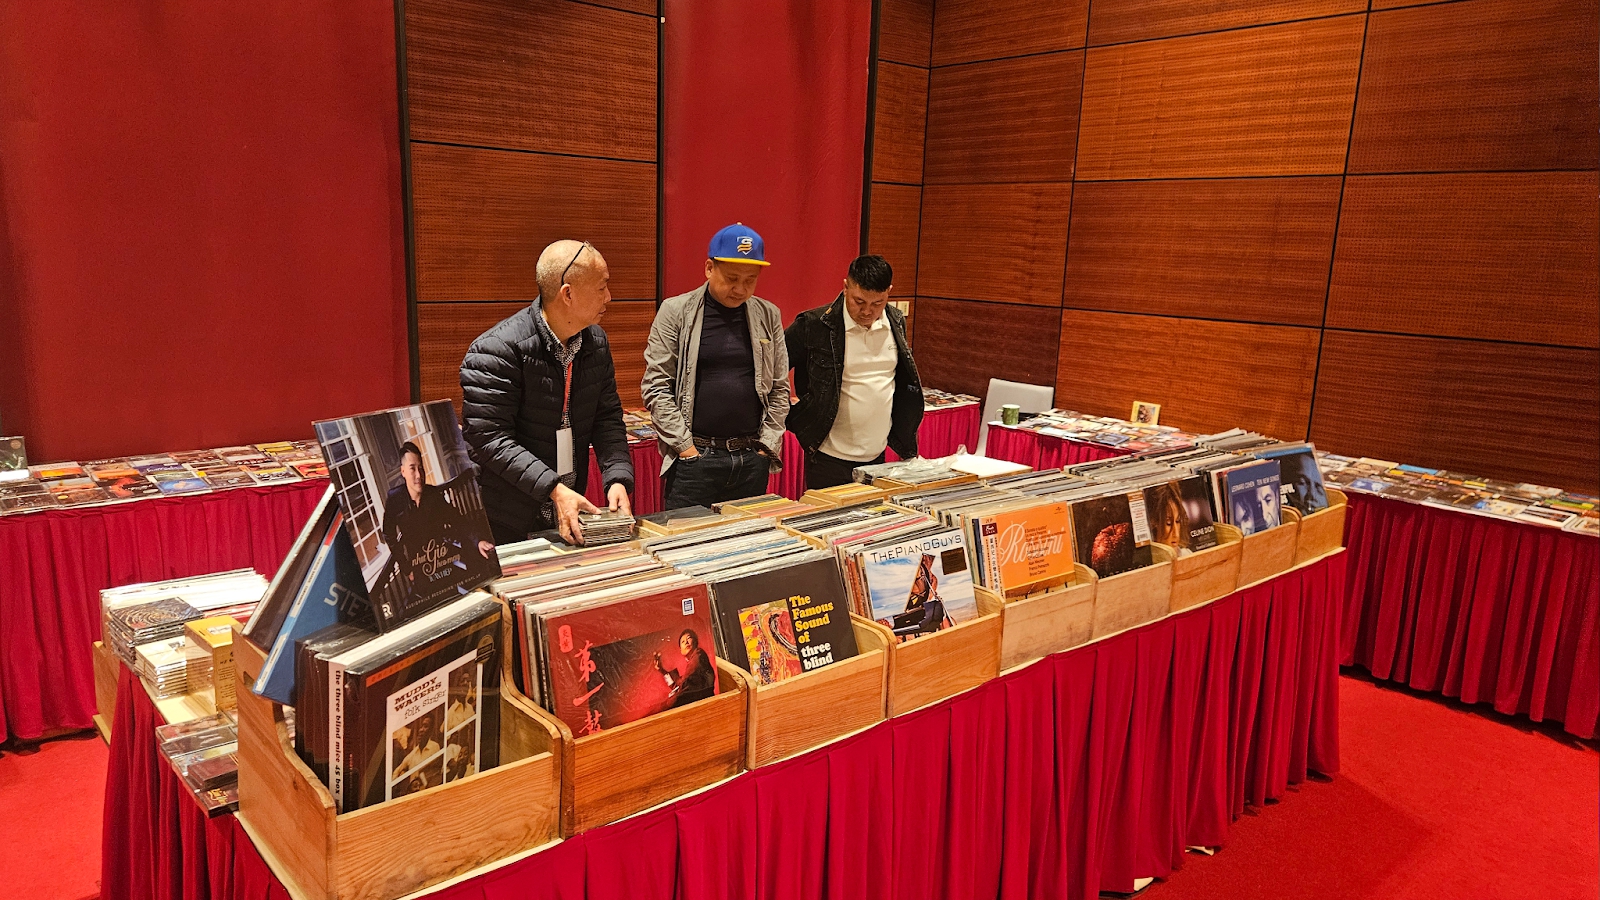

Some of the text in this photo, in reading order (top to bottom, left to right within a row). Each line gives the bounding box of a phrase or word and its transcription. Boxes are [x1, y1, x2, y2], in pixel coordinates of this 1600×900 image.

[788, 595, 811, 608] The
[792, 602, 834, 620] Famous
[795, 613, 831, 632] Sound
[798, 631, 811, 644] of
[801, 642, 832, 658] three
[803, 652, 834, 670] blind
[393, 682, 442, 712] WATERS
[394, 677, 438, 705] MUDDY
[404, 689, 447, 719] folk singer
